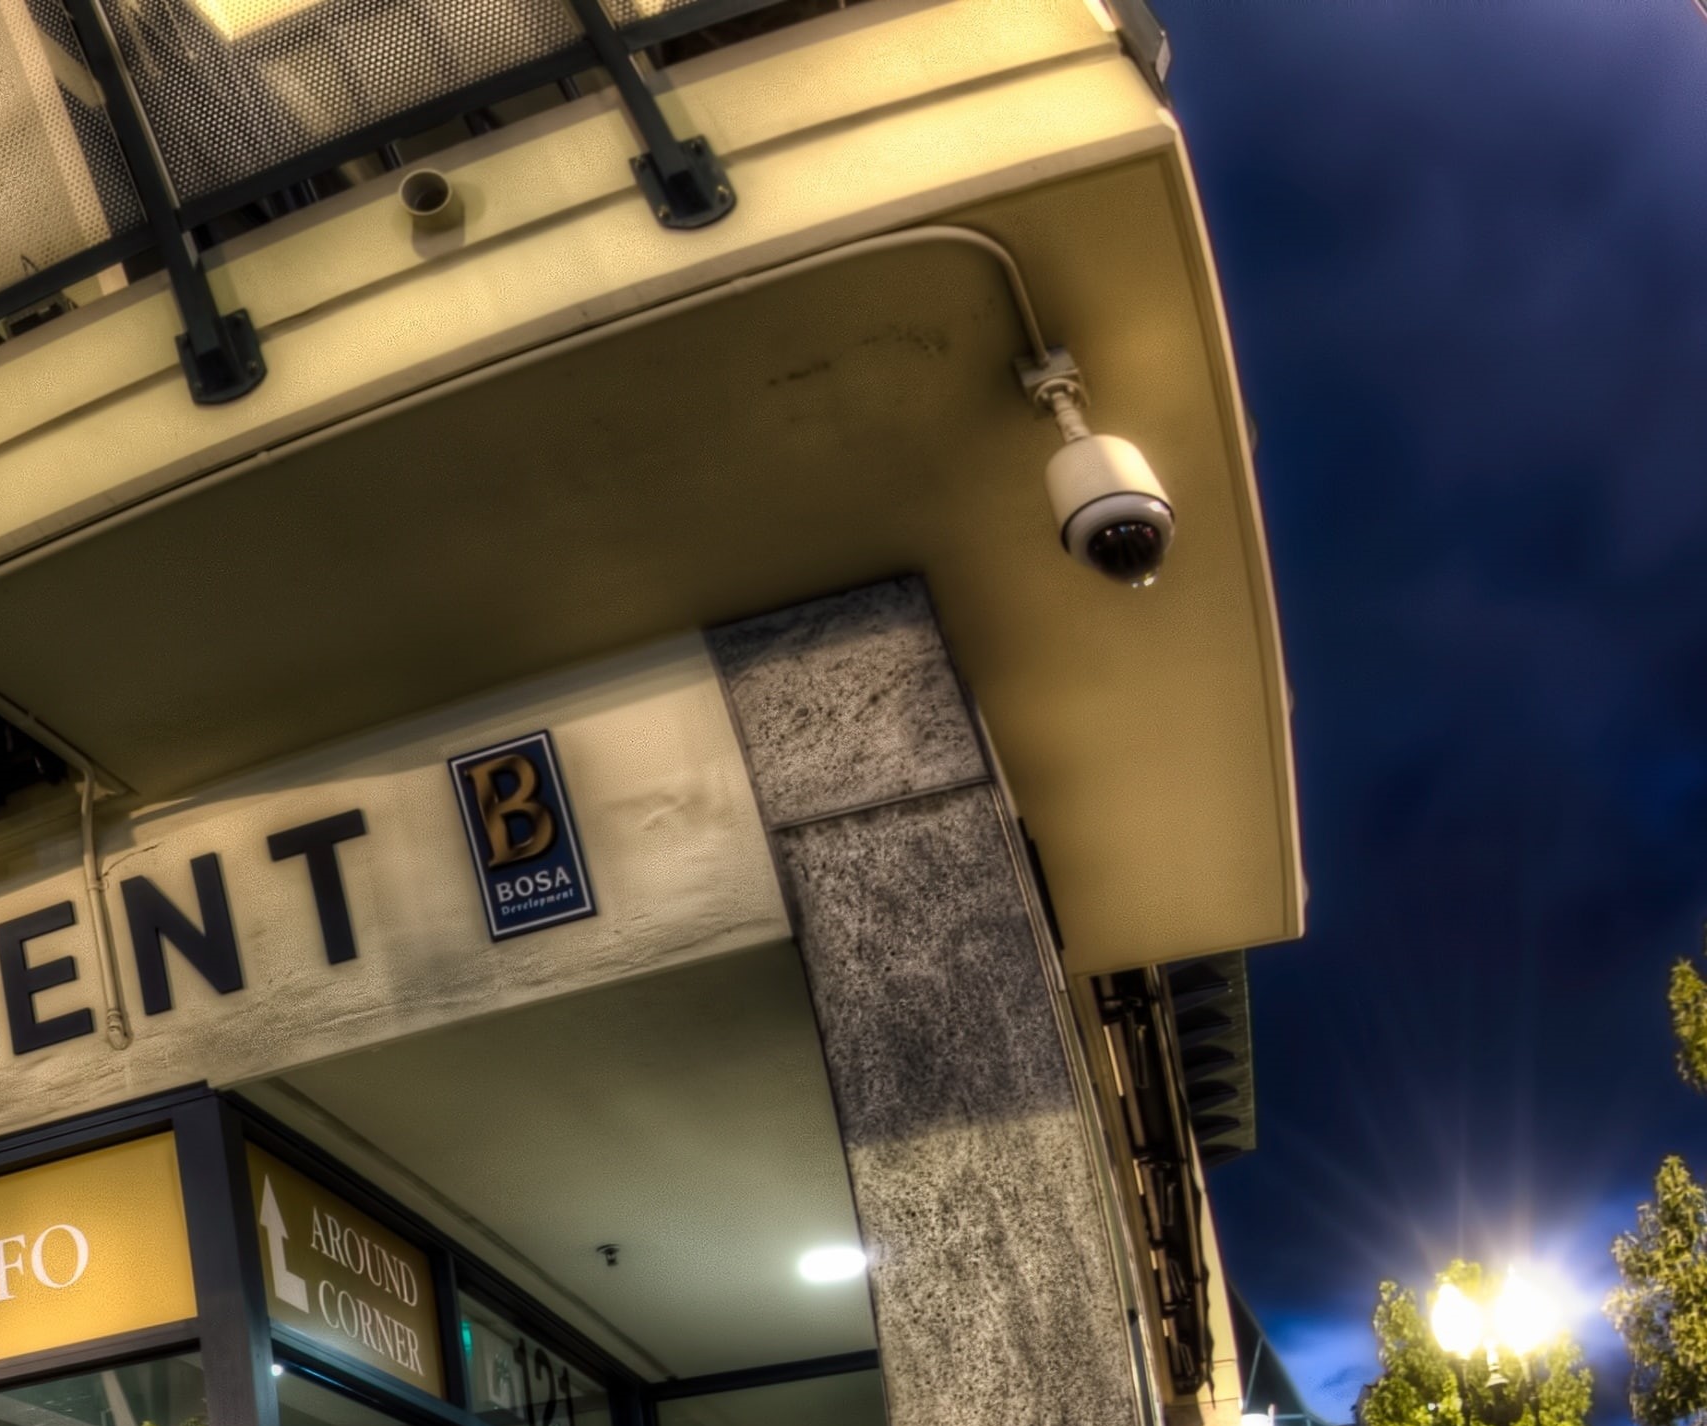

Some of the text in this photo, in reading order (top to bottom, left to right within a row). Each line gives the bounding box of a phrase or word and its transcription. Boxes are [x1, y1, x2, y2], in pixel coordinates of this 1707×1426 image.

[467, 753, 557, 868] B
[495, 866, 572, 903] BOSA
[500, 887, 575, 916] Development
[311, 1206, 419, 1308] AROUND
[318, 1279, 425, 1378] CORNER
